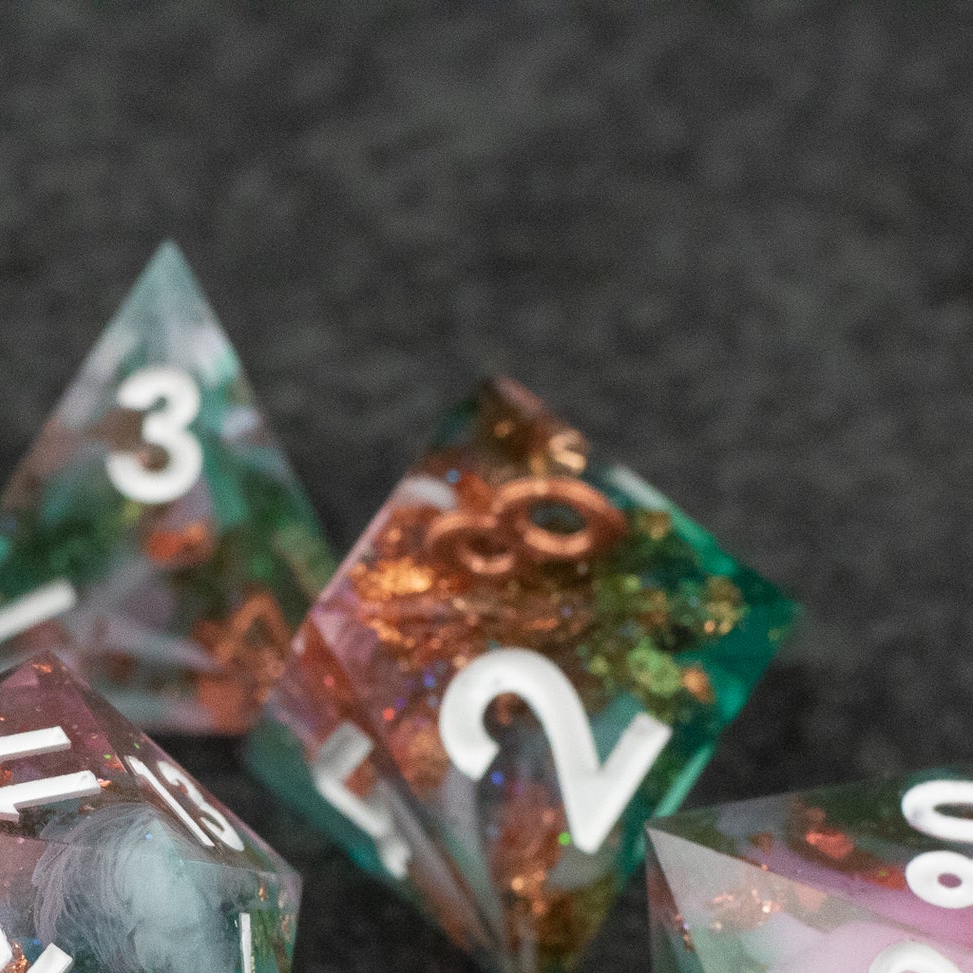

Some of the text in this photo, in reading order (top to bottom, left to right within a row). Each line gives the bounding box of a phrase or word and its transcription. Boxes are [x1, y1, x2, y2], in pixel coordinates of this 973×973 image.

[108, 365, 204, 504] 3
[123, 755, 245, 852] 13
[439, 648, 673, 855] 2
